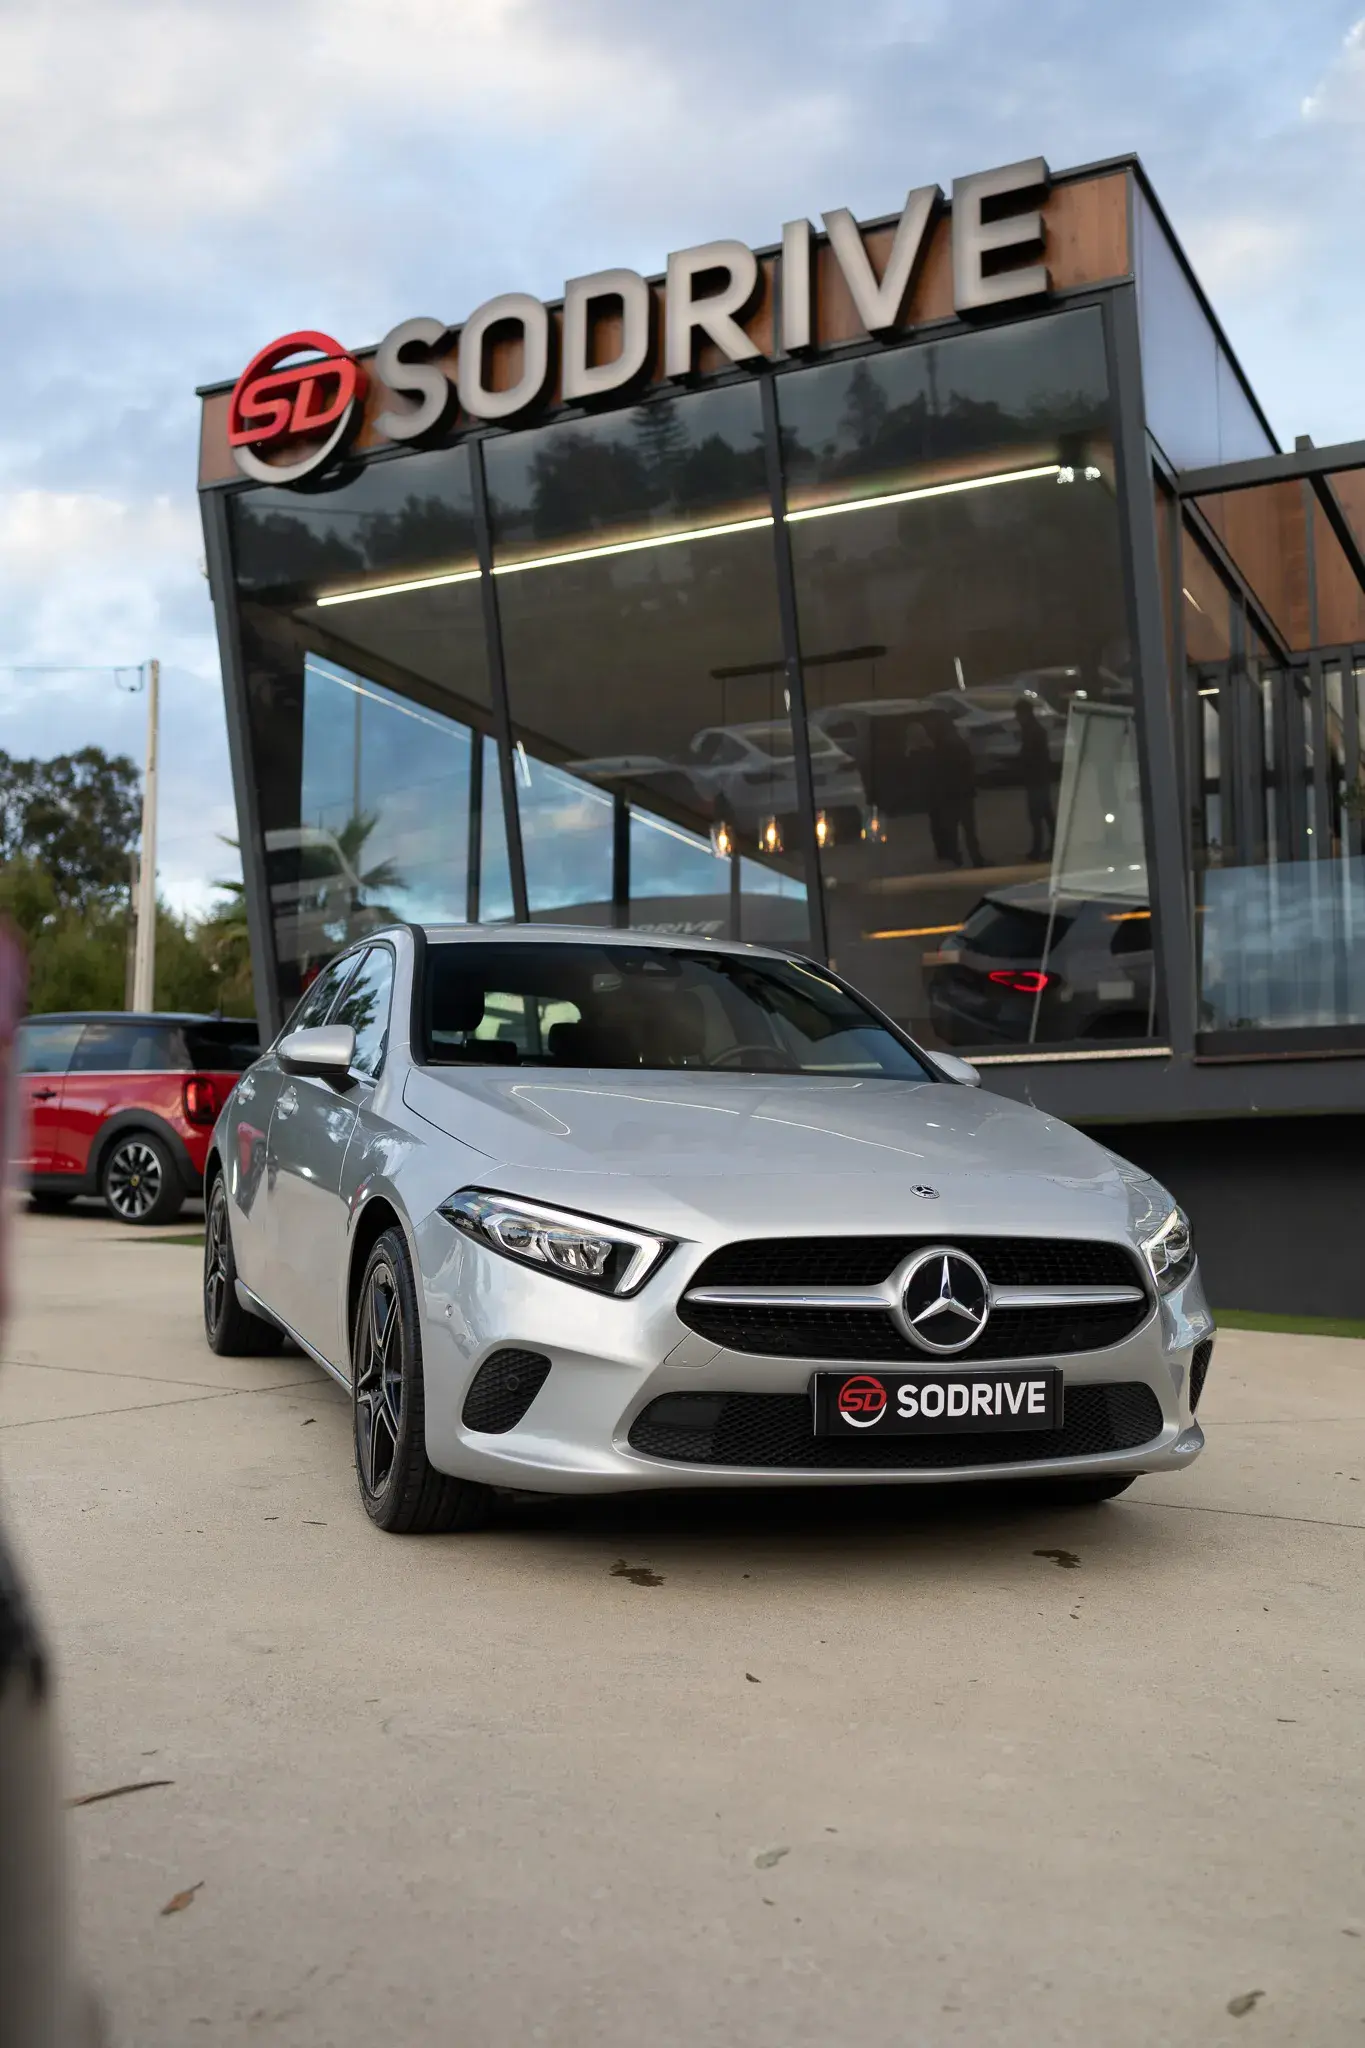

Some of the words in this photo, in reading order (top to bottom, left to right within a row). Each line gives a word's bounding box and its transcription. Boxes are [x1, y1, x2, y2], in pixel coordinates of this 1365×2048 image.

[228, 356, 357, 447] SD
[372, 156, 1052, 444] SODRIVE
[839, 1388, 887, 1411] SD
[897, 1381, 1046, 1418] SODRIVE
